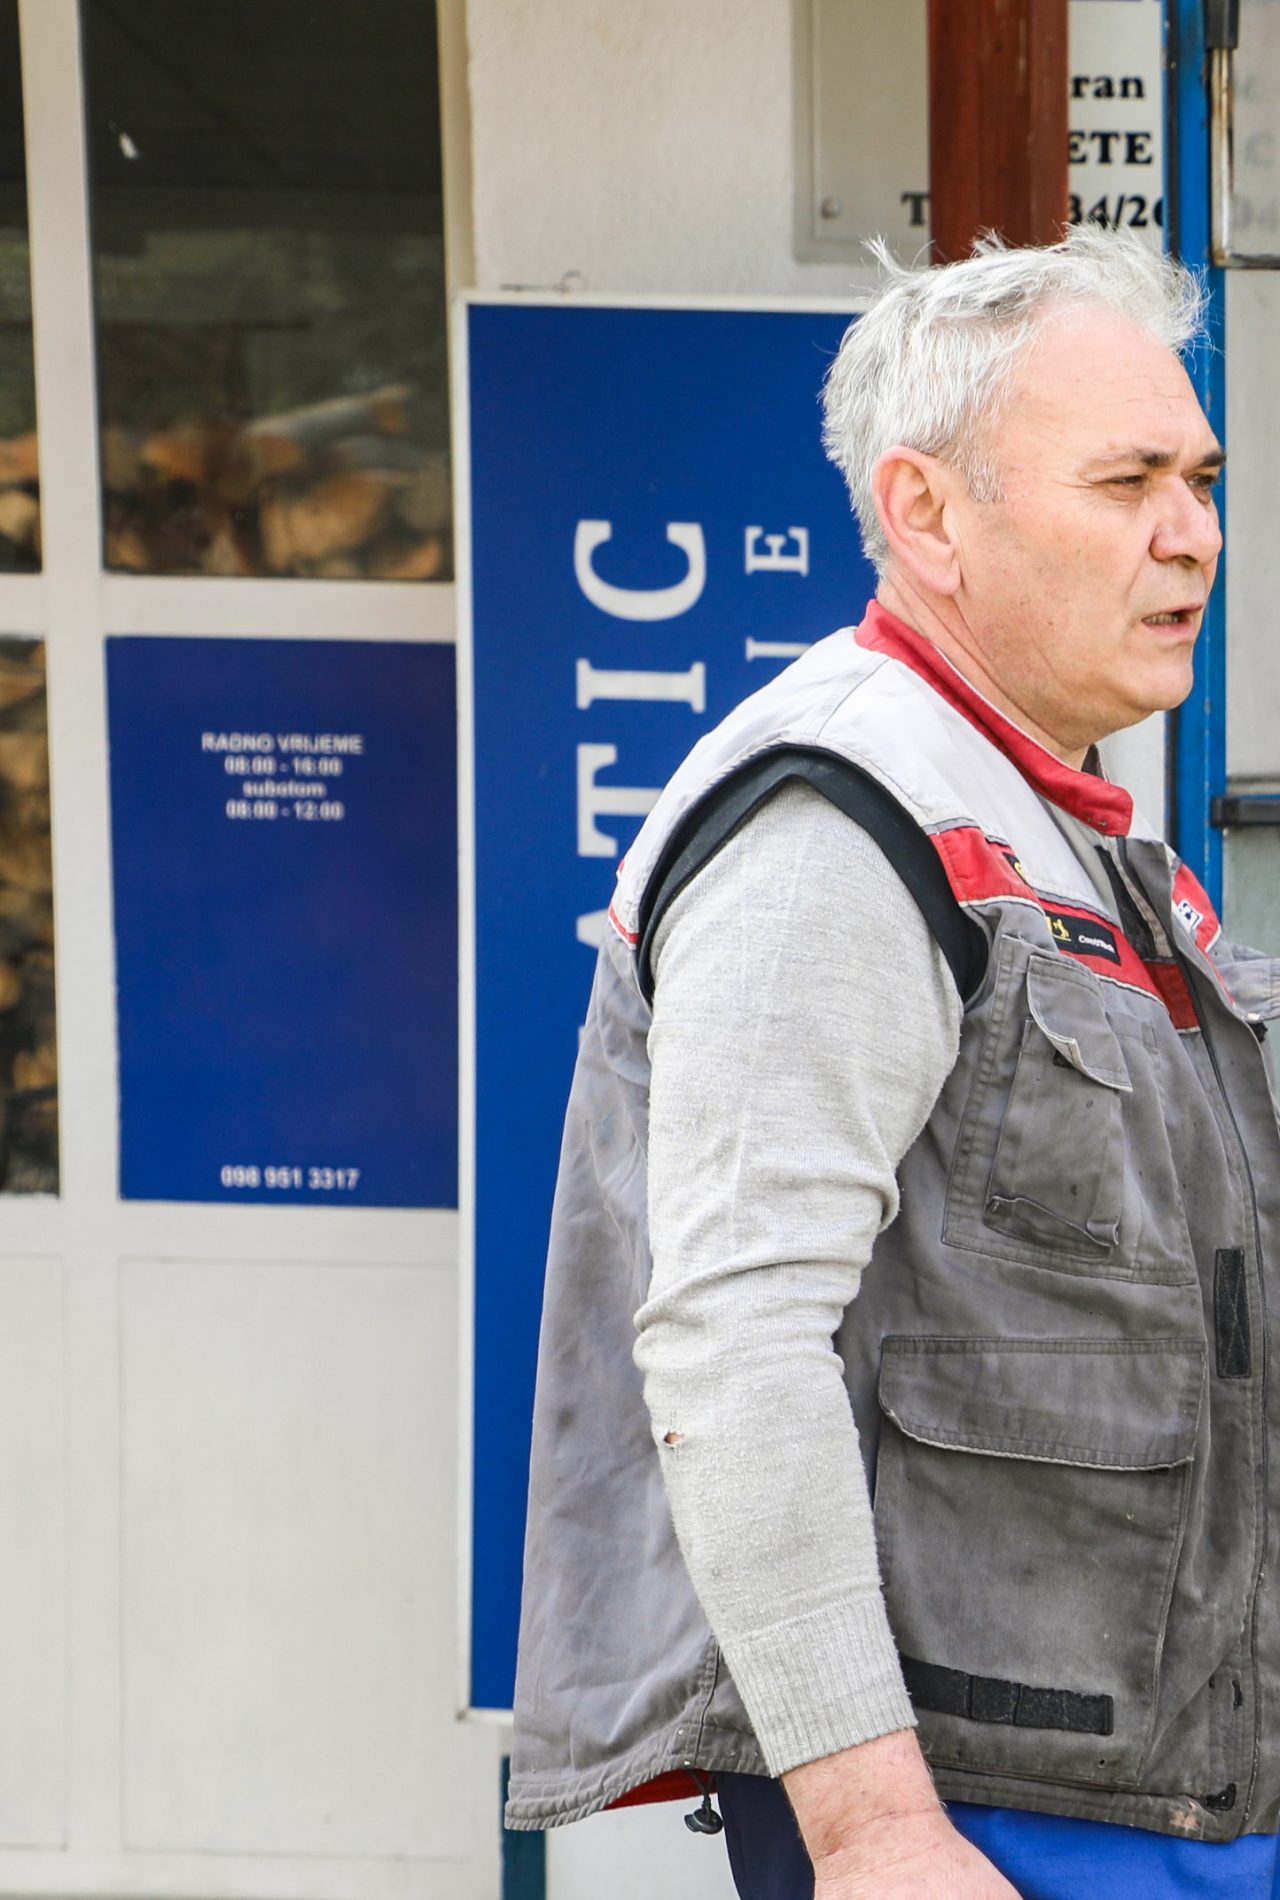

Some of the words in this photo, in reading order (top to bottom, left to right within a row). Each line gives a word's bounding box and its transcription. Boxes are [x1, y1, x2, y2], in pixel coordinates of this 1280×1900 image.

[1071, 74, 1145, 99] ran
[901, 192, 931, 227] T
[202, 733, 275, 752] RADNO
[277, 733, 364, 754] VRIJEME
[574, 519, 706, 948] TIC
[221, 1165, 260, 1188] 098
[308, 1167, 360, 1190] 3317
